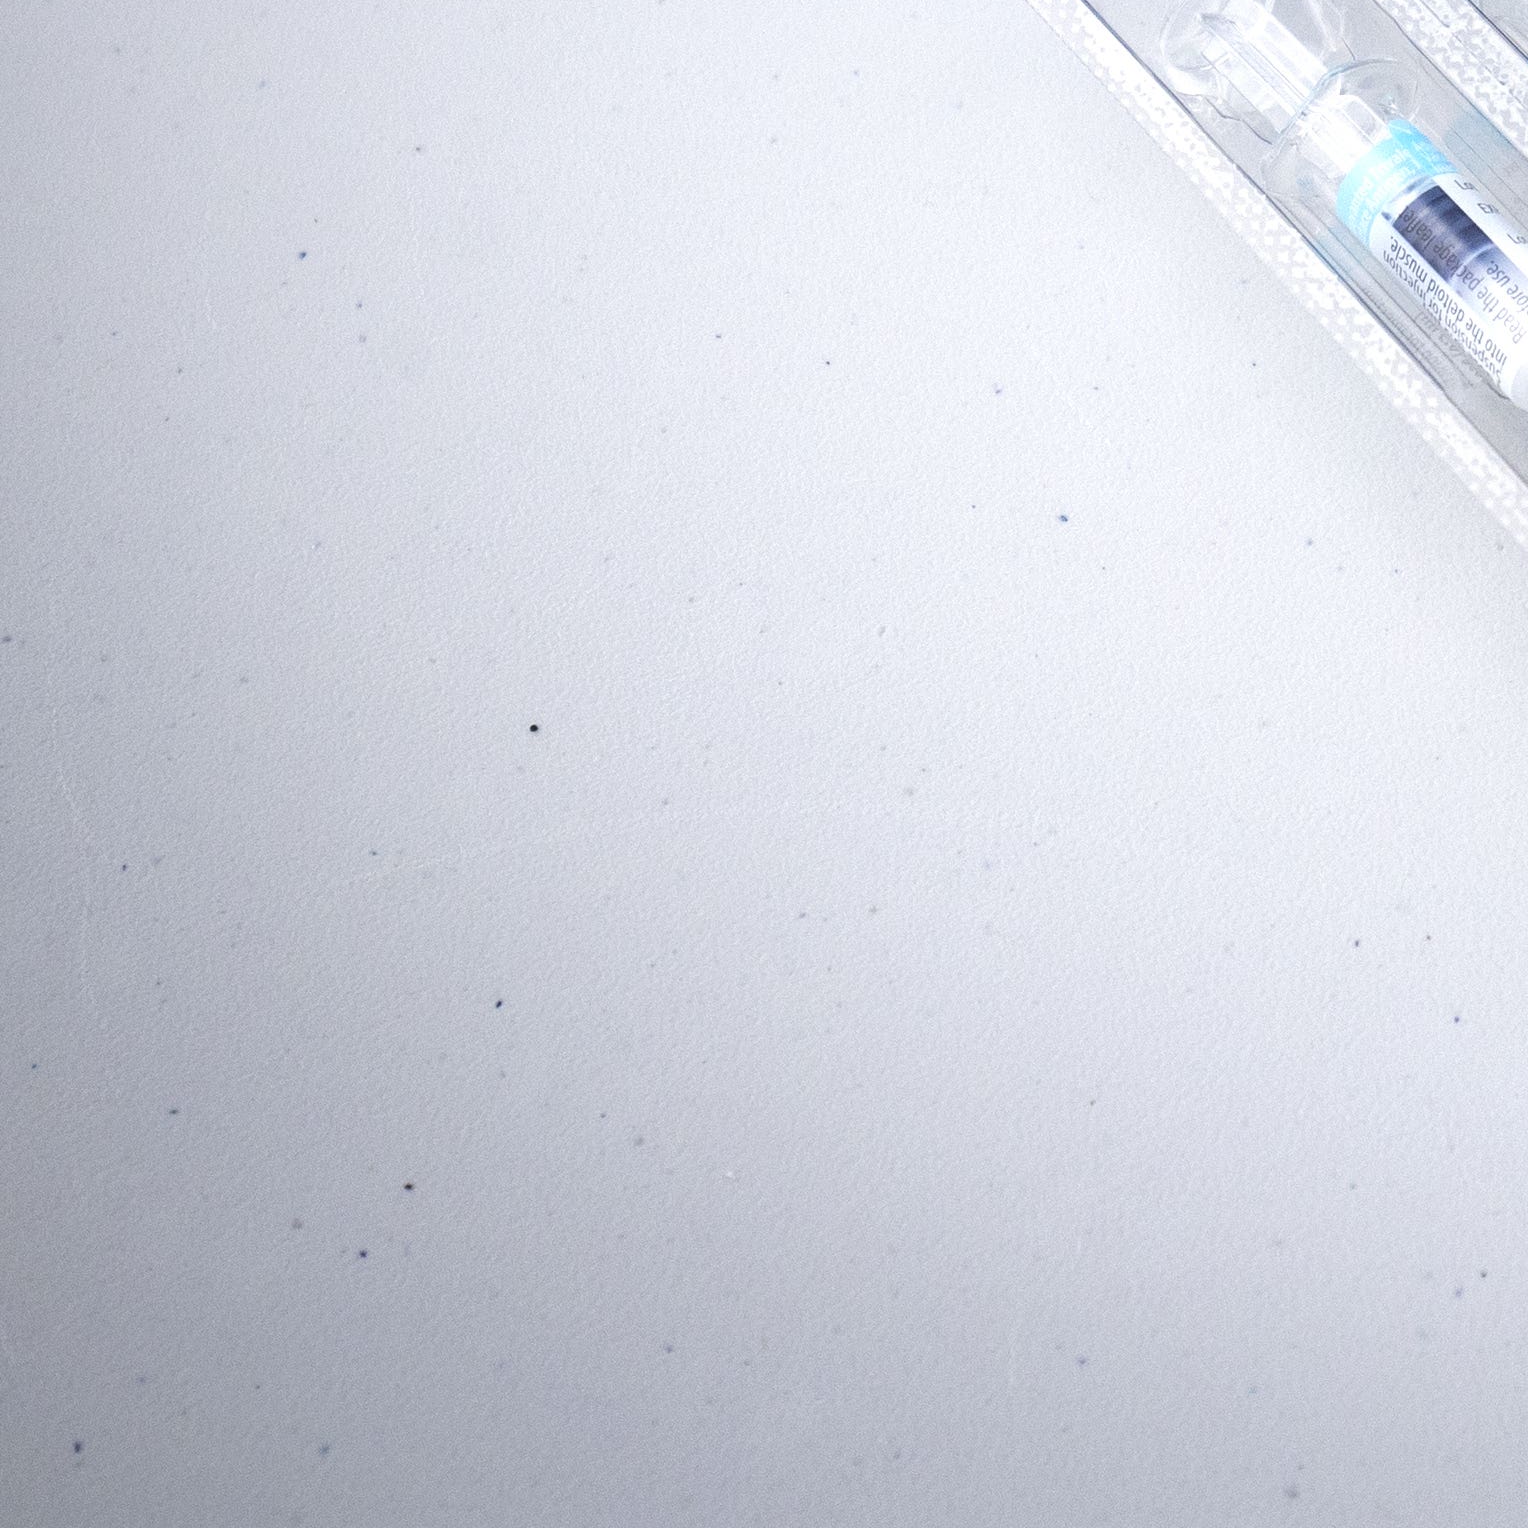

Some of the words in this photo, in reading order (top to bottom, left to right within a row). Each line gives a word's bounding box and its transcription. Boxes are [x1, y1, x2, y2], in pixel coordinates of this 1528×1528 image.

[1390, 236, 1429, 283] muscle.
[1432, 242, 1485, 291] package
[1486, 260, 1511, 287] use.
[1426, 278, 1465, 323] deltoid
[1477, 287, 1499, 313] the
[1465, 318, 1484, 344] the
[1491, 307, 1527, 345] Read
